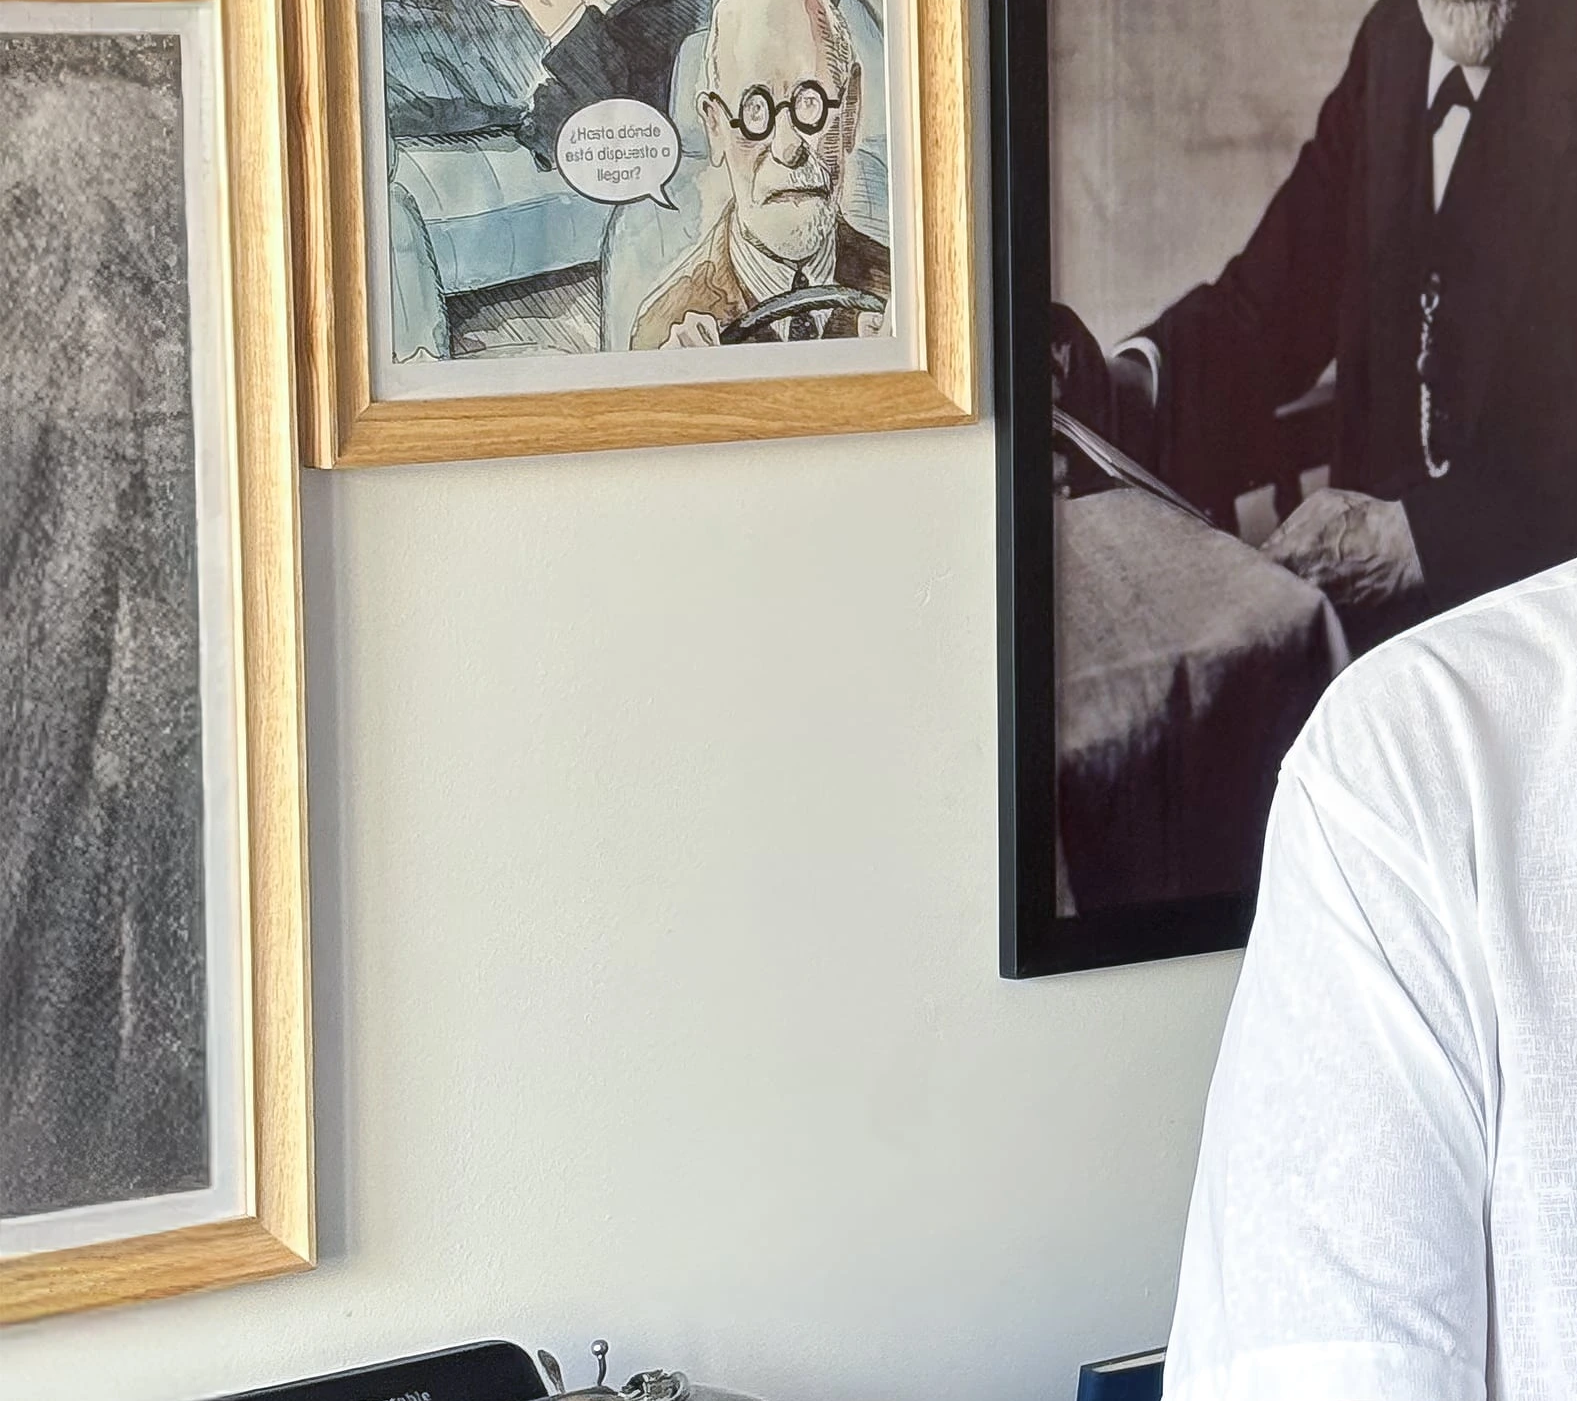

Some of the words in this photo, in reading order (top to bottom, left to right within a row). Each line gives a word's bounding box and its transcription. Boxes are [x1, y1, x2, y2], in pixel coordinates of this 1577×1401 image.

[570, 126, 613, 145] ¿Hasta
[617, 124, 662, 140] dónde
[565, 147, 594, 162] está
[597, 145, 659, 163] dispuesto
[661, 146, 671, 158] a
[597, 165, 642, 184] llegar?
